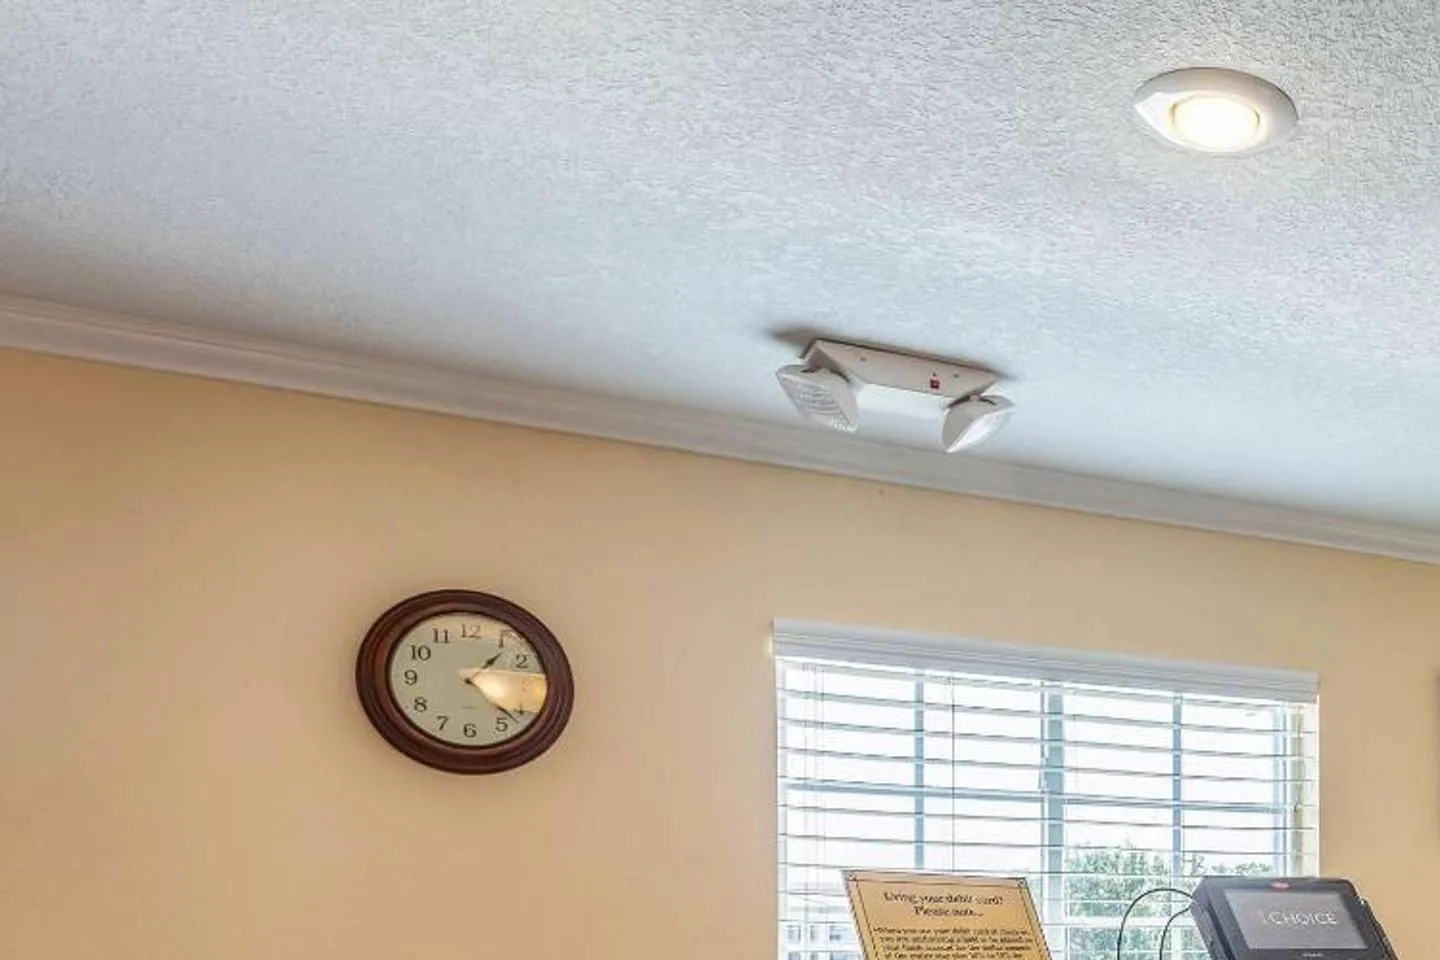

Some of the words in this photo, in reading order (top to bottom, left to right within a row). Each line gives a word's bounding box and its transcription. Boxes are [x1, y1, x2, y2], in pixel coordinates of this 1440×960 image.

[432, 627, 450, 643] 11
[460, 623, 481, 639] 12
[410, 645, 431, 661] 10
[515, 653, 529, 669] 2
[404, 669, 418, 685] 9
[414, 696, 428, 712] 8
[437, 715, 449, 731] 7
[463, 723, 477, 738] 6
[495, 717, 508, 732] 5
[1268, 911, 1337, 926] CHOICE
